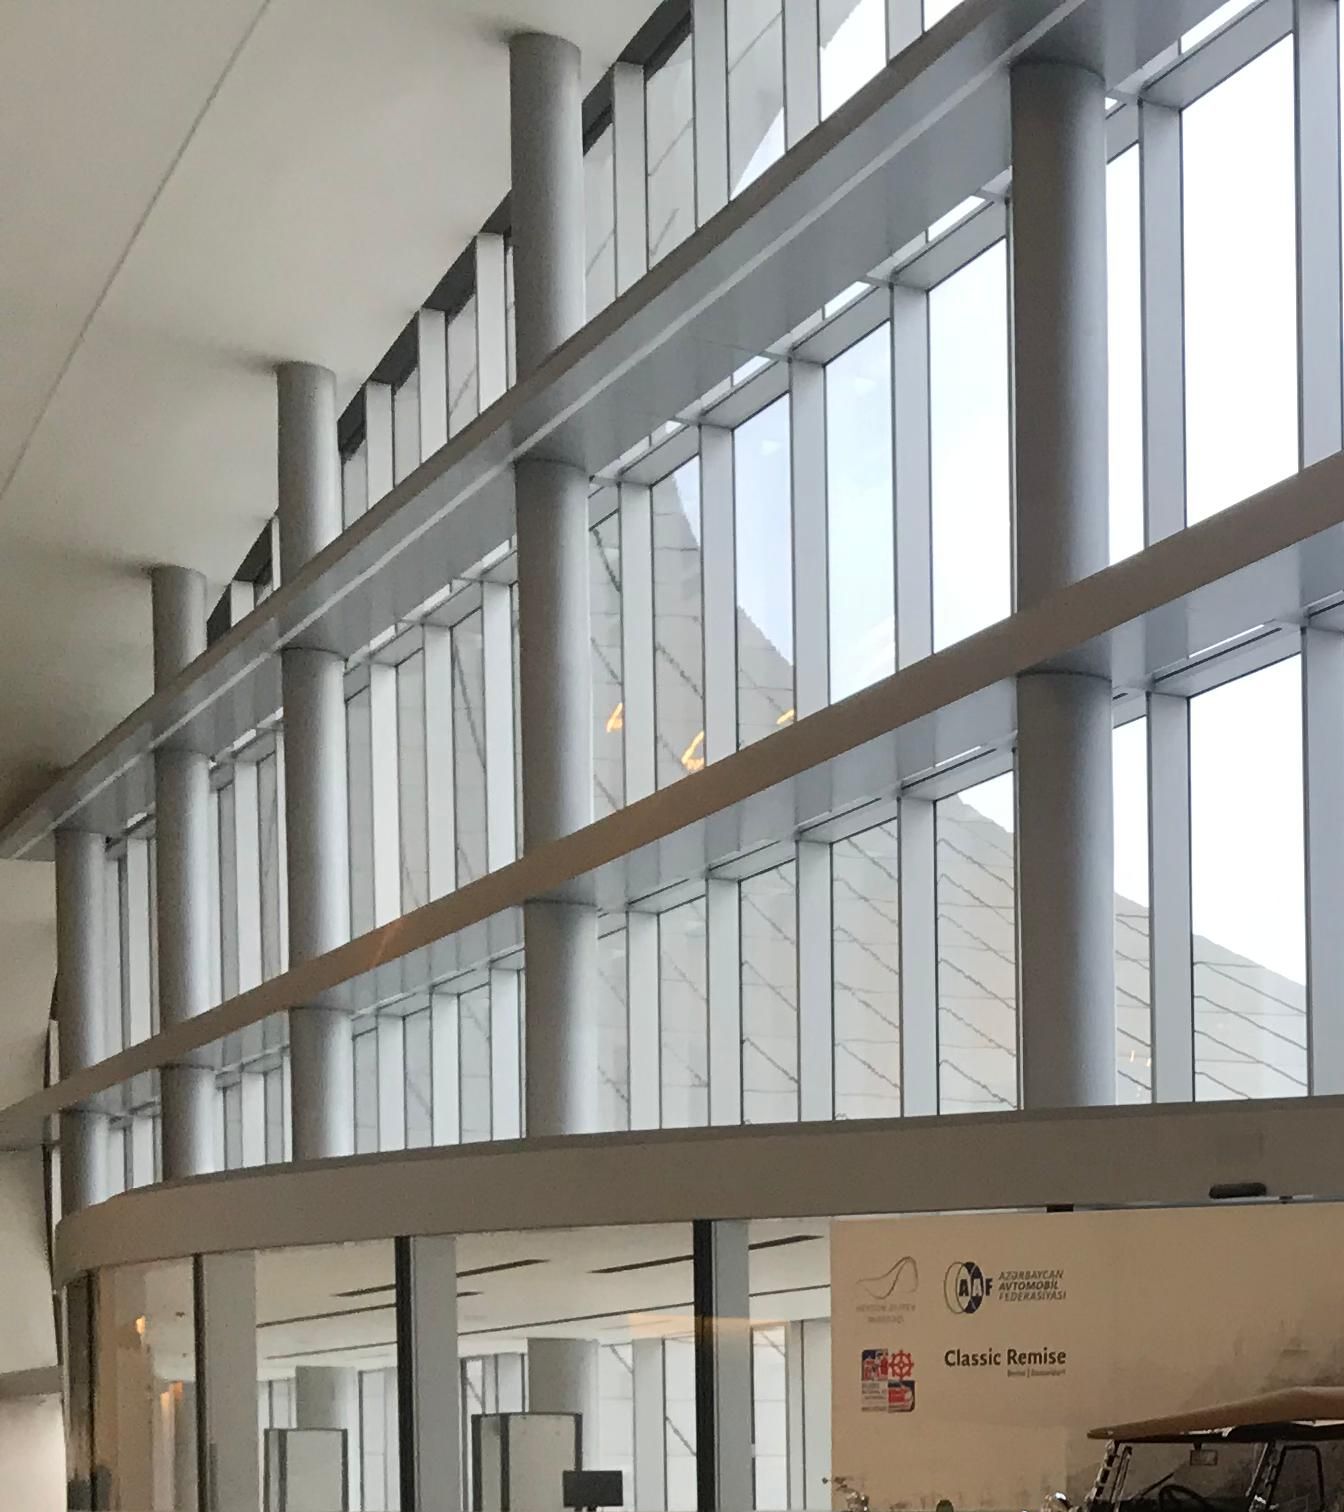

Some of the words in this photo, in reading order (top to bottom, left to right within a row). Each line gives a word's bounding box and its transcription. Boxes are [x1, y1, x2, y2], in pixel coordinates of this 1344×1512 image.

[958, 1277, 993, 1297] AAF
[944, 1347, 1001, 1367] Classic
[1007, 1346, 1066, 1366] Remise
